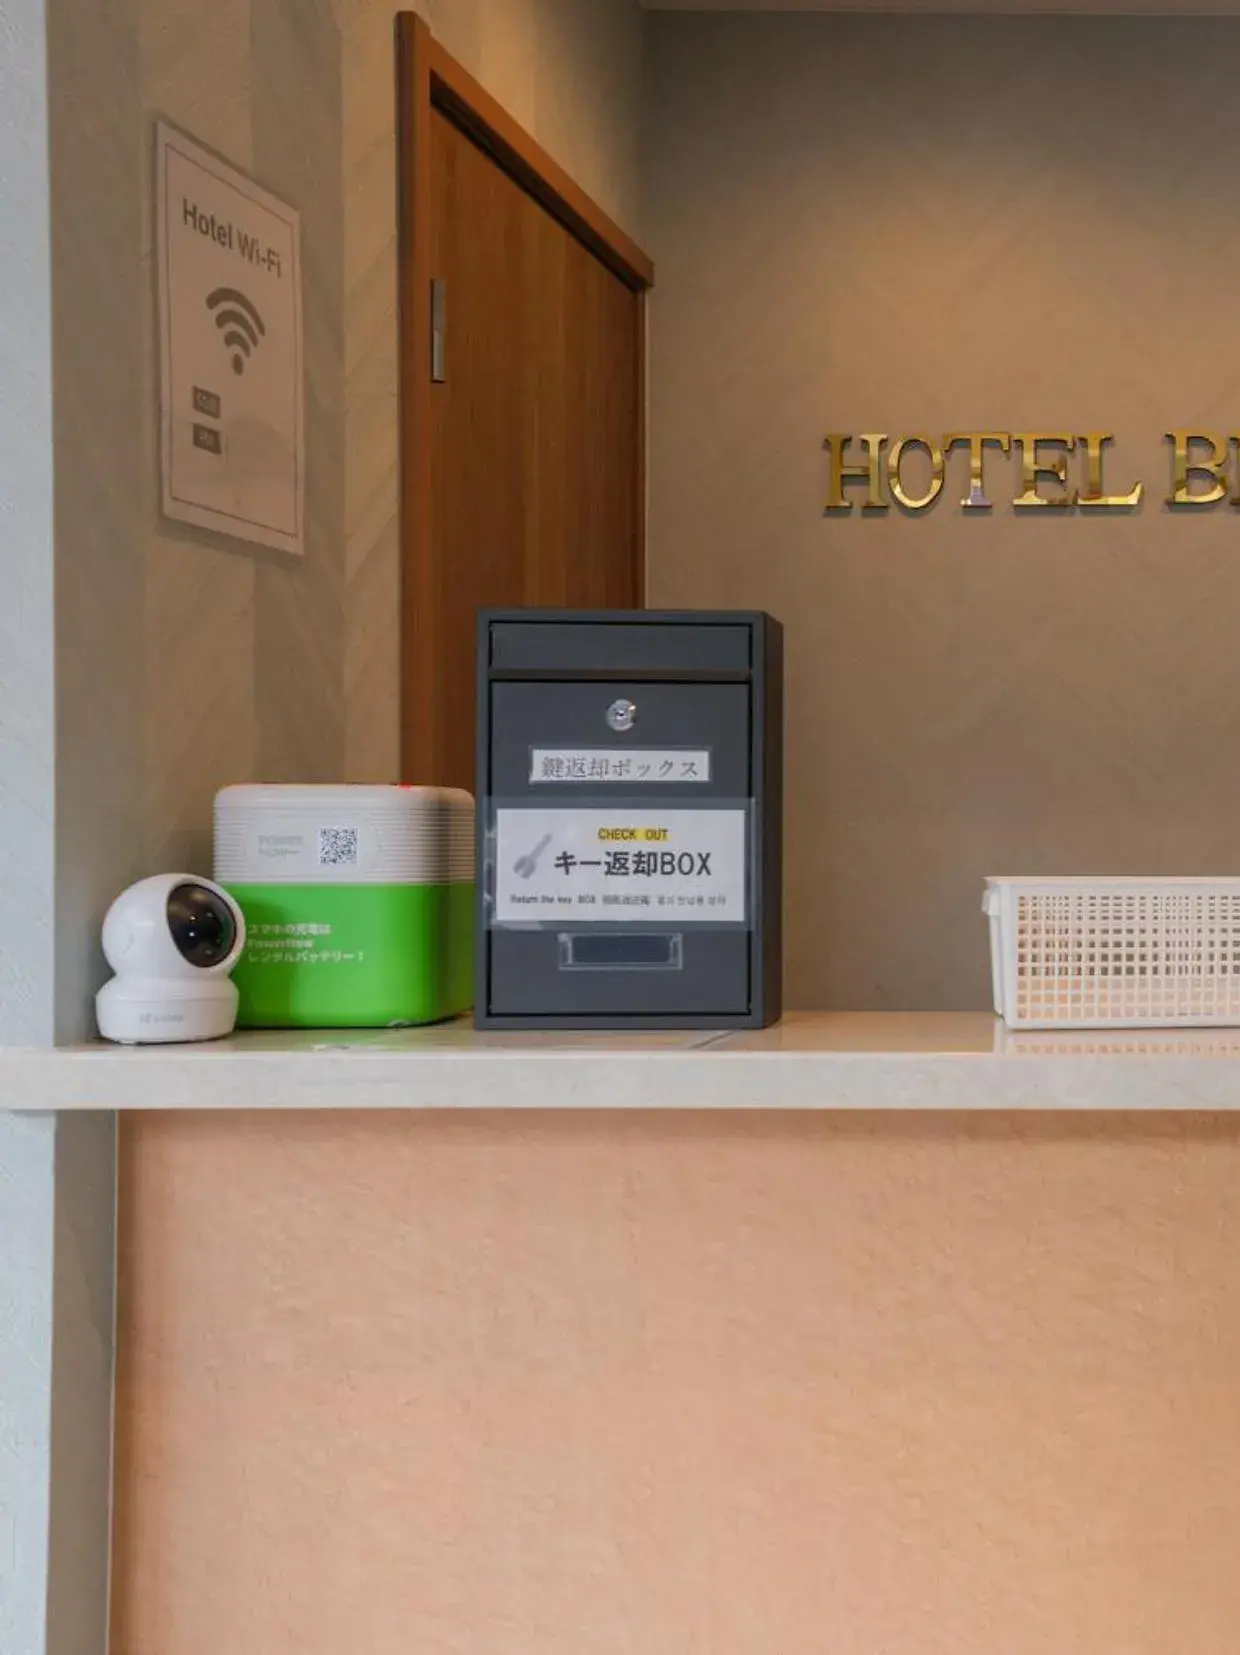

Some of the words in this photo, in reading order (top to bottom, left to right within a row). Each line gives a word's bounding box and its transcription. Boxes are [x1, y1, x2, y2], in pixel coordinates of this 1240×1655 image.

[183, 198, 233, 250] Hotel
[237, 229, 282, 279] Wi-Fi
[823, 431, 1143, 509] HOTEL
[541, 756, 699, 778] 鍵返却ボックス
[598, 828, 636, 840] CHECK
[645, 828, 668, 840] OUT
[554, 851, 712, 876] キー返却BOX
